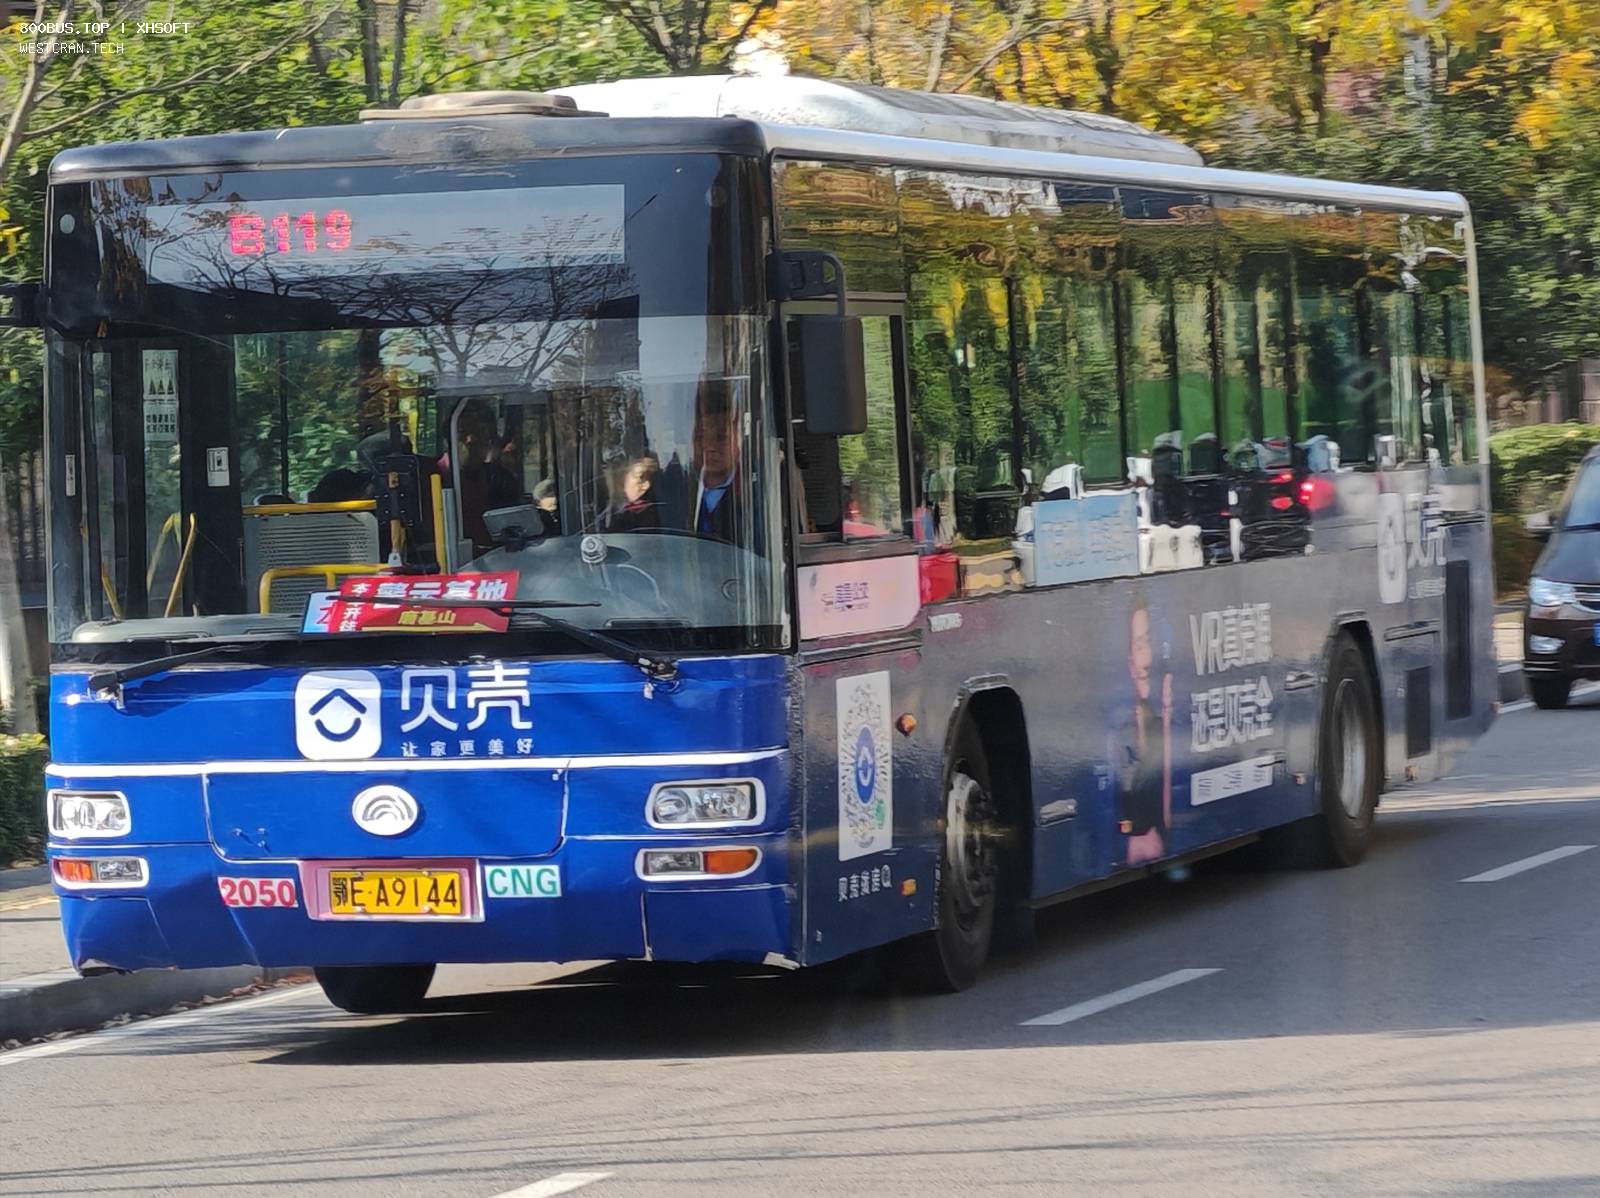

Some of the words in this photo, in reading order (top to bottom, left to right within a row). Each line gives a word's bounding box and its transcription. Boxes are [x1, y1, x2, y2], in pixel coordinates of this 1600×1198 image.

[229, 208, 353, 256] B119
[400, 659, 534, 733] 贝壳
[401, 737, 535, 758] 让家更美好
[221, 878, 297, 907] 2050
[488, 867, 559, 896] CNG
